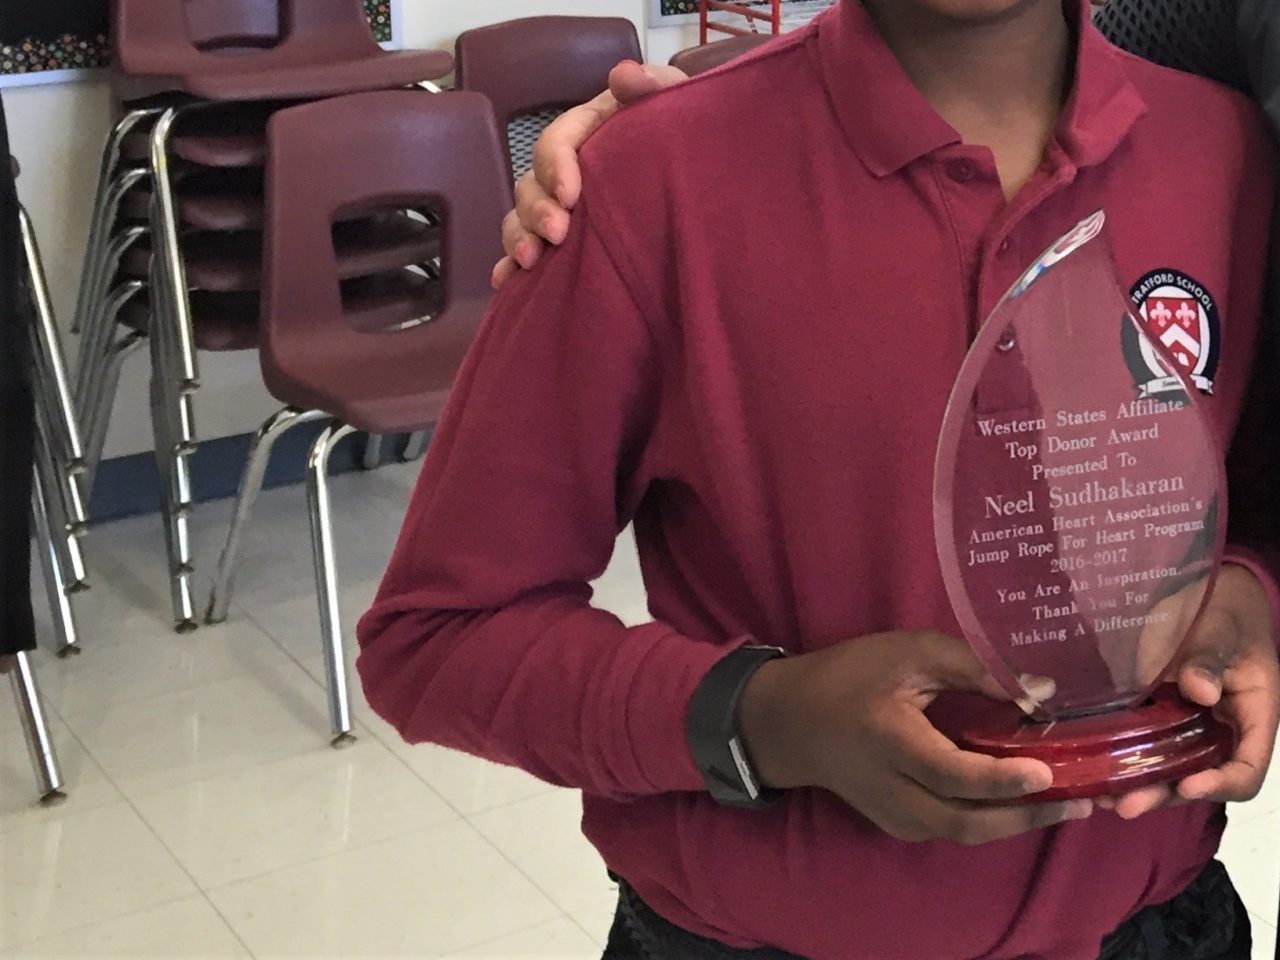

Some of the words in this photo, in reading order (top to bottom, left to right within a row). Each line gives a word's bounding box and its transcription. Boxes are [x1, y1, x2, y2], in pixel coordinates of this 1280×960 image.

[1131, 273, 1175, 304] TRATFORD
[1176, 276, 1213, 311] SCHOOL
[978, 417, 1047, 437] Western
[1056, 409, 1107, 427] States
[1116, 398, 1185, 420] Affiliate
[1005, 441, 1038, 460] Top
[1047, 435, 1097, 454] Donor
[1107, 423, 1159, 445] Award
[1032, 454, 1109, 480] Presented
[1116, 451, 1137, 468] To
[984, 490, 1035, 519] Neel
[1048, 475, 1184, 510] Sudhakaran
[967, 549, 1010, 567] Jump
[1018, 541, 1054, 558] Rope
[1062, 534, 1088, 551] For
[1095, 528, 1136, 546] Heart
[1143, 519, 1205, 539] Program
[968, 523, 1044, 545] American
[1052, 514, 1096, 531] Heart
[1050, 547, 1128, 574] 2016-2017
[996, 589, 1026, 604] You
[1034, 583, 1061, 598] Are
[1068, 579, 1089, 593] An
[1032, 602, 1079, 621] Thank
[1124, 591, 1150, 606] For
[1009, 626, 1068, 648] Making
[1074, 623, 1086, 637] A
[1094, 610, 1169, 632] Difference
